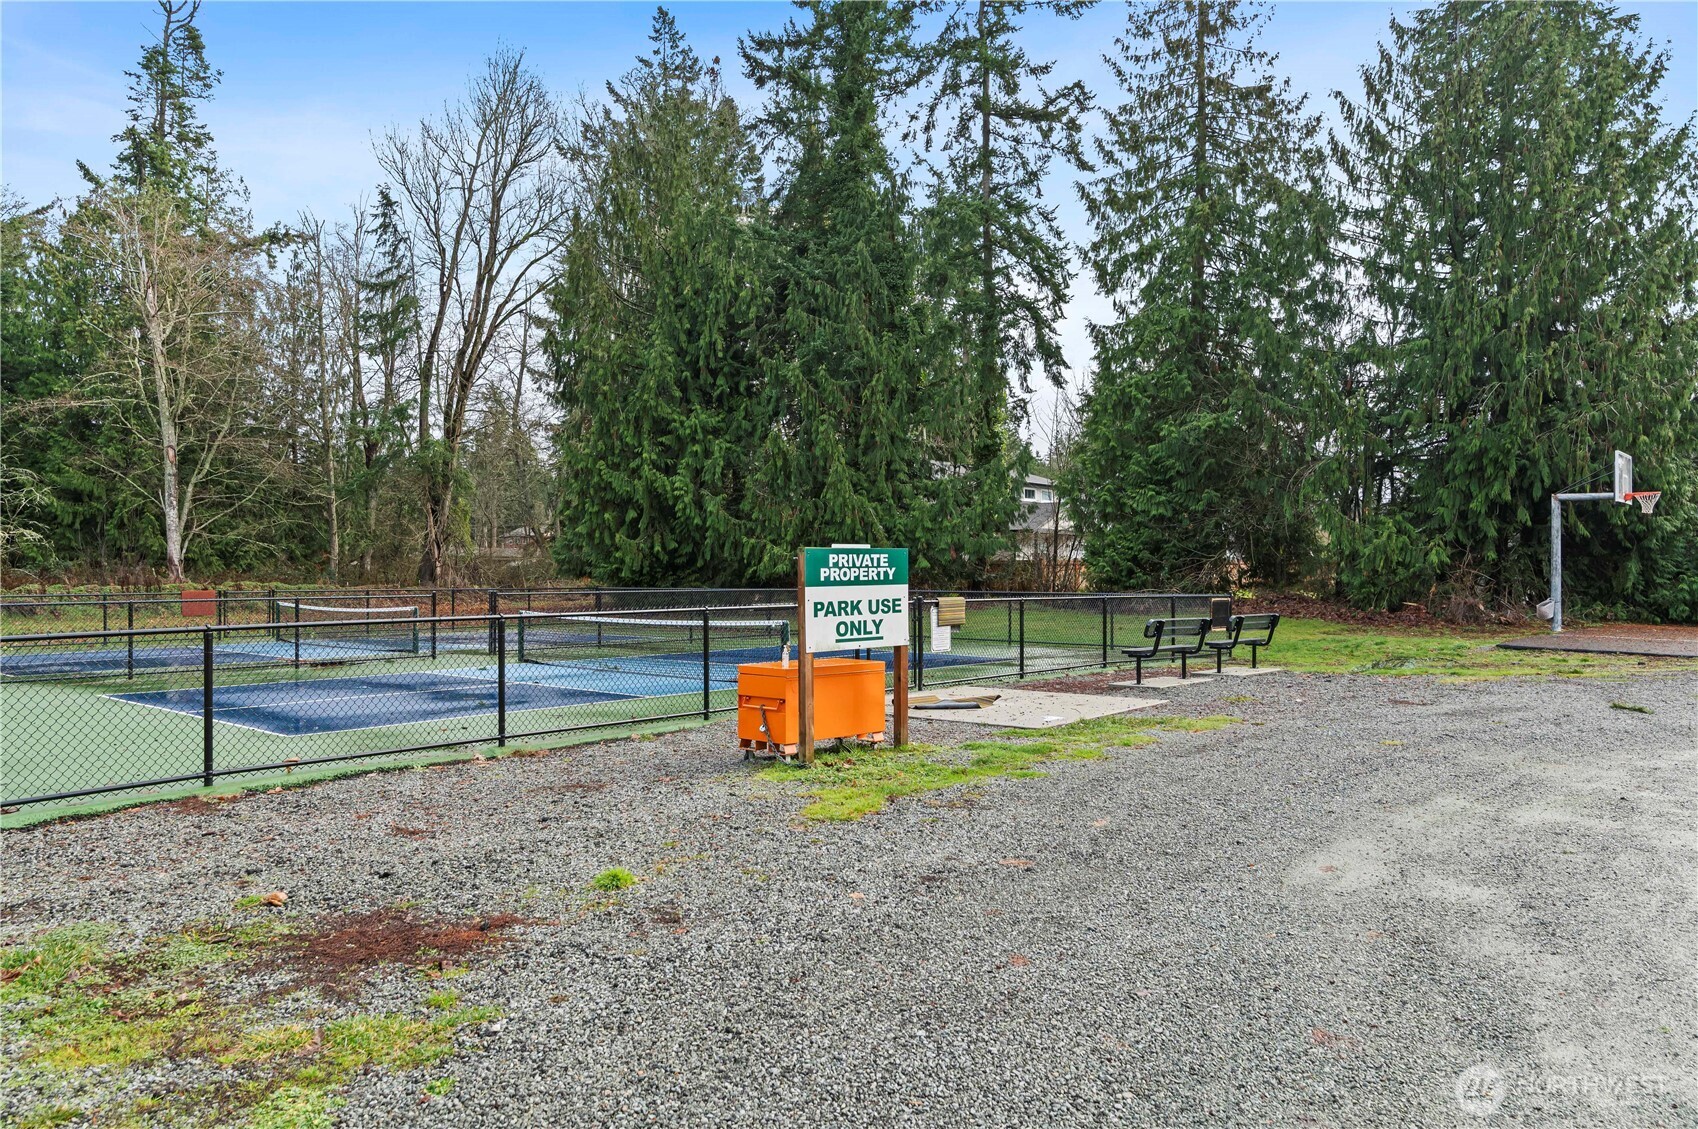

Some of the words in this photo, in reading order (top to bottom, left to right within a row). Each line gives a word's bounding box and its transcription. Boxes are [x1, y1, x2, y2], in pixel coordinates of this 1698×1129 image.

[829, 554, 889, 567] PRIVATE
[820, 567, 896, 581] PROPERTY
[813, 600, 863, 618] PARK
[868, 598, 902, 615] USE
[836, 619, 884, 637] ONLY
